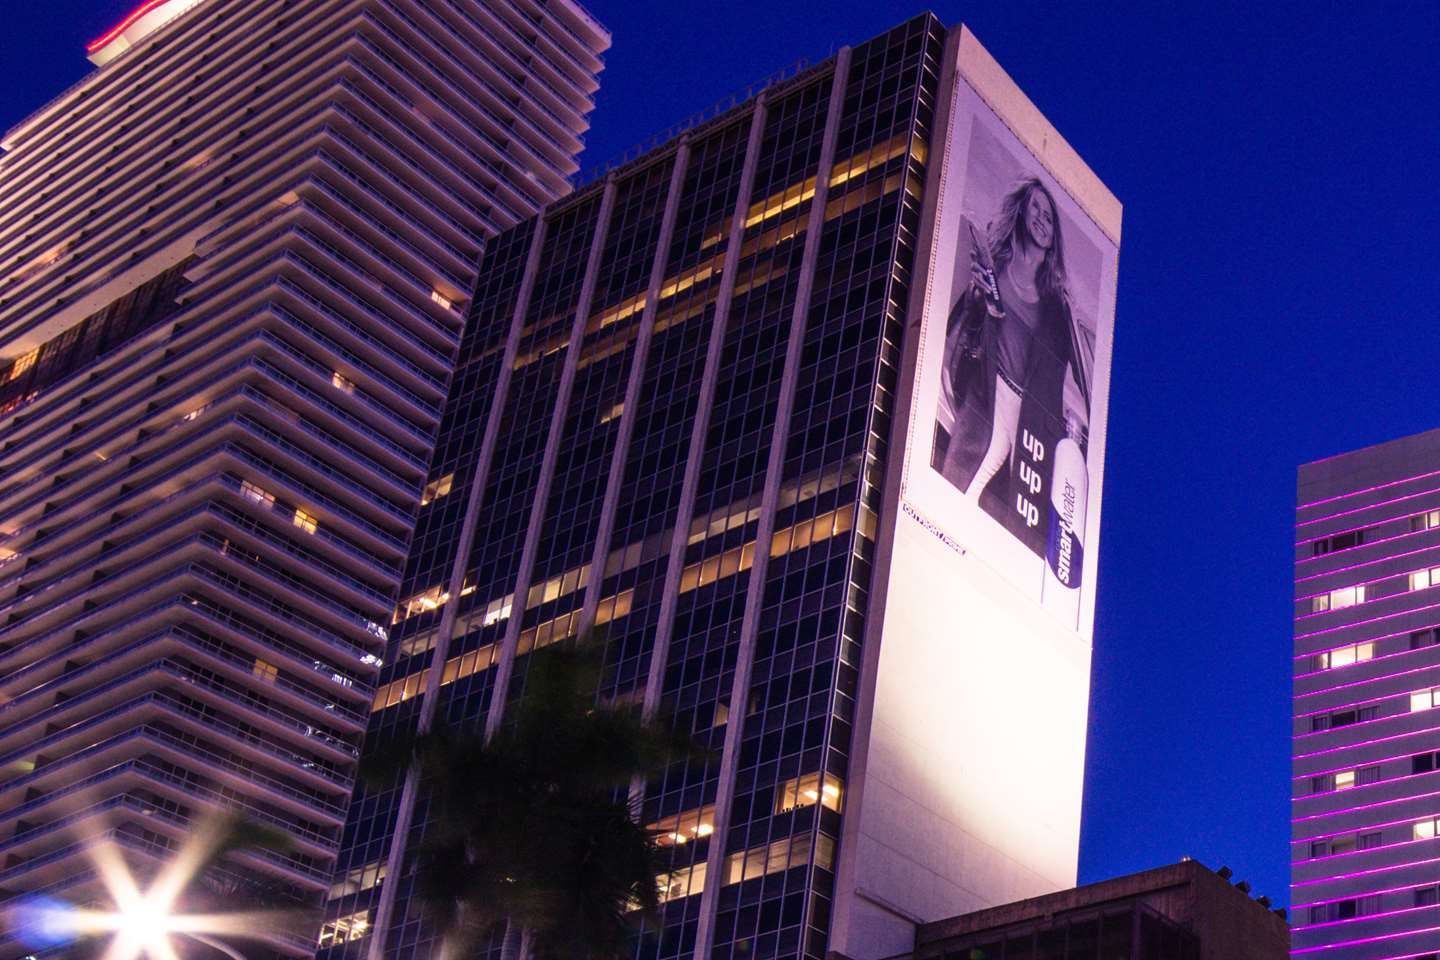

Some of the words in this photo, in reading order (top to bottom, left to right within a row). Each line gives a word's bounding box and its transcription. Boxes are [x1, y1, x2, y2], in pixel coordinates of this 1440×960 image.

[1023, 428, 1044, 462] up
[1019, 462, 1042, 494] up
[1017, 494, 1038, 527] up
